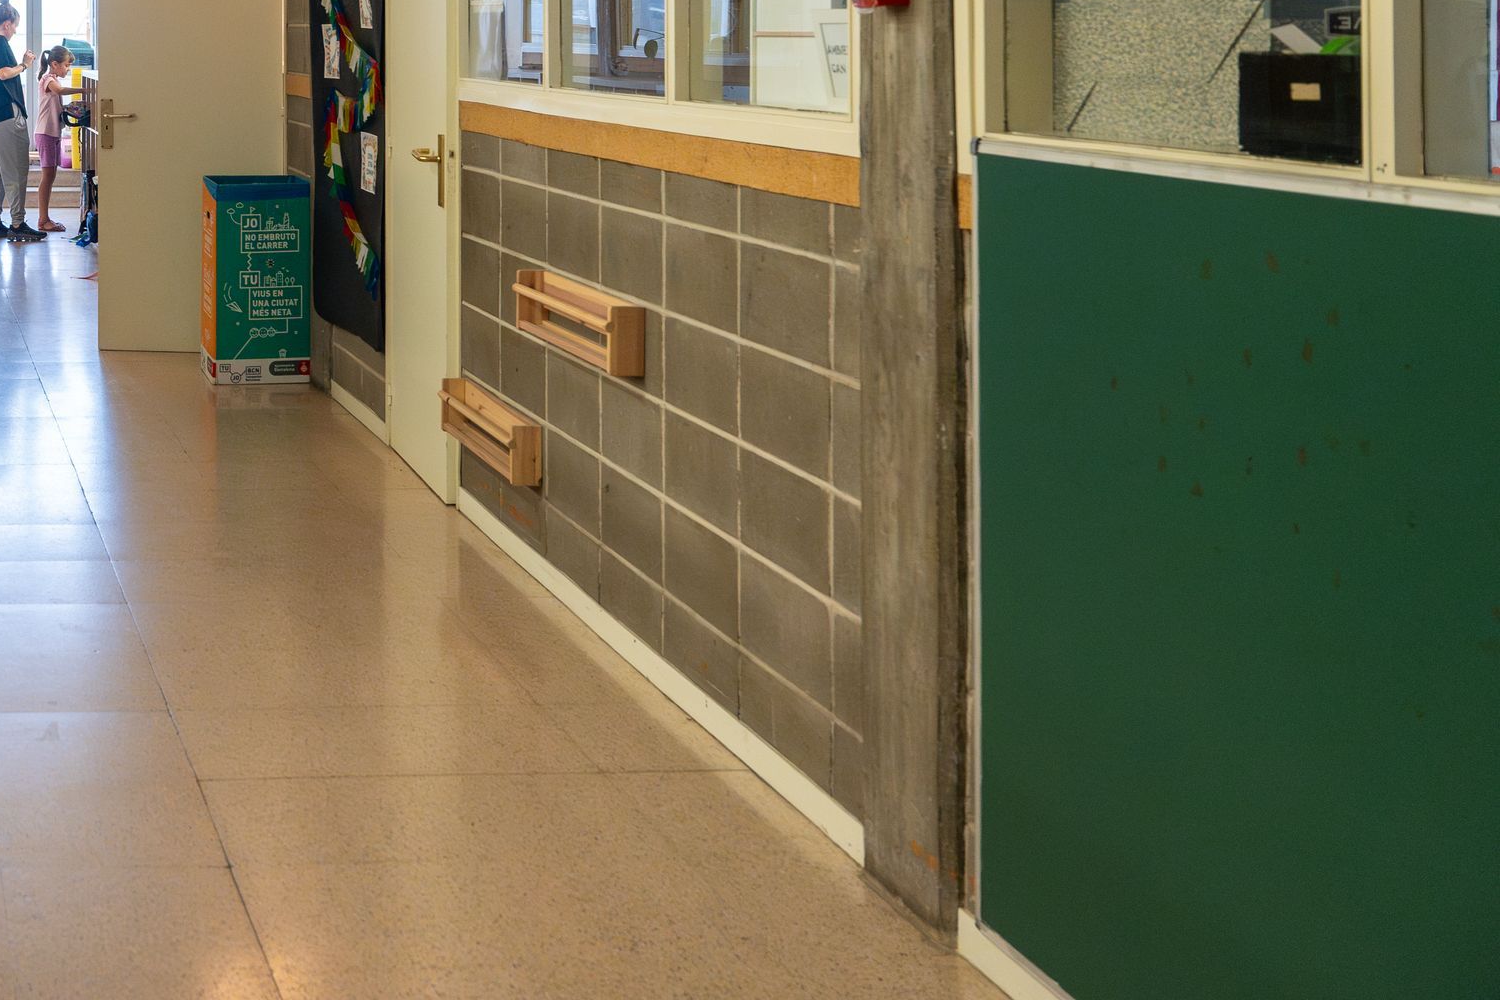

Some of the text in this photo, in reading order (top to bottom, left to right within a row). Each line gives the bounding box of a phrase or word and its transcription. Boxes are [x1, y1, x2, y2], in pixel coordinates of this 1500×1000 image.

[243, 218, 258, 228] JO
[245, 232, 296, 242] NO EMBRUTO
[245, 241, 289, 250] EL CARRER
[242, 274, 258, 285] TU
[252, 290, 271, 298] VIUS
[271, 298, 299, 306] CIUTAT
[271, 308, 292, 316] NETA
